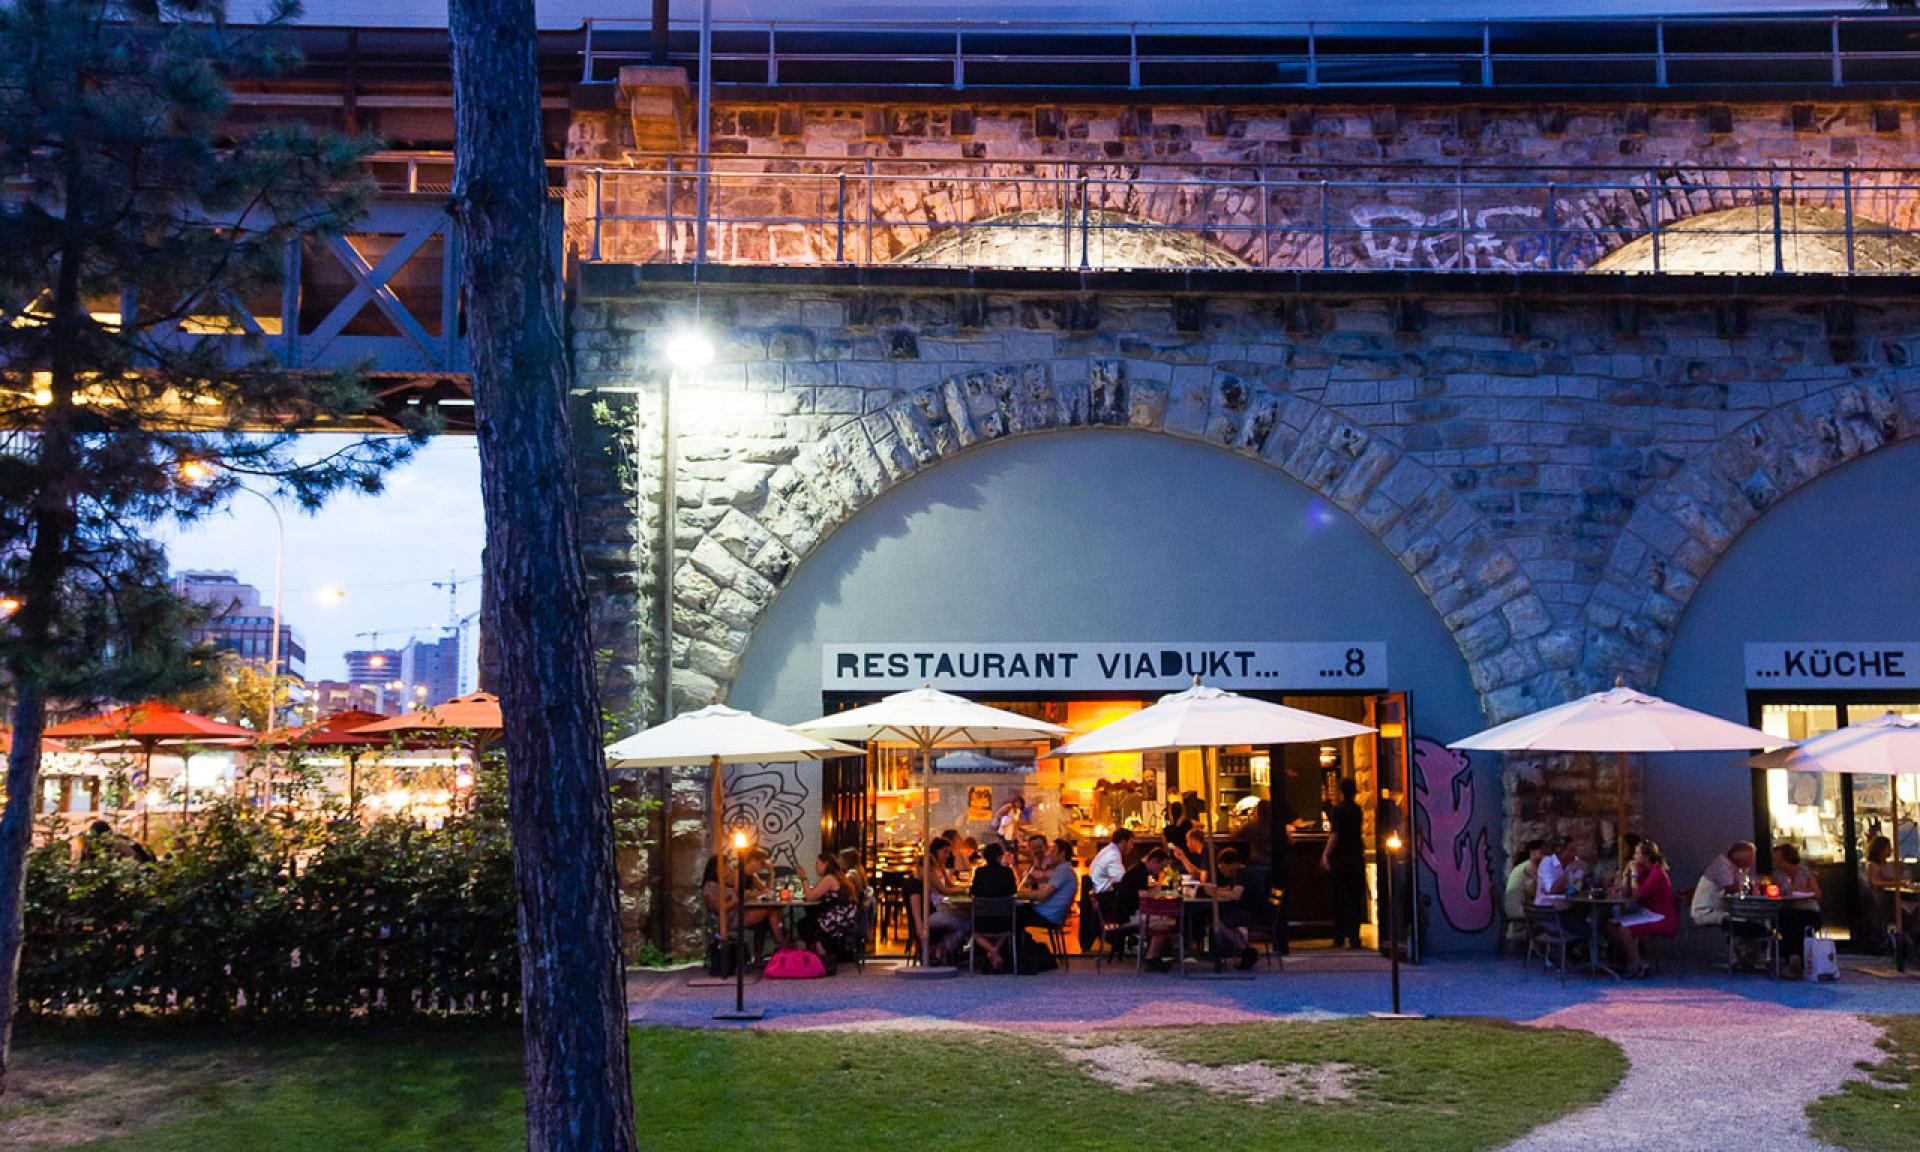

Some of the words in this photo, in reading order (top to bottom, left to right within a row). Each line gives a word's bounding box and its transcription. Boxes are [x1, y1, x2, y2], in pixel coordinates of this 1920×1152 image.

[836, 653, 1078, 678] RESTAURANT
[1097, 650, 1279, 679] VIADUKT...
[1756, 649, 1906, 677] ...KÜCHE
